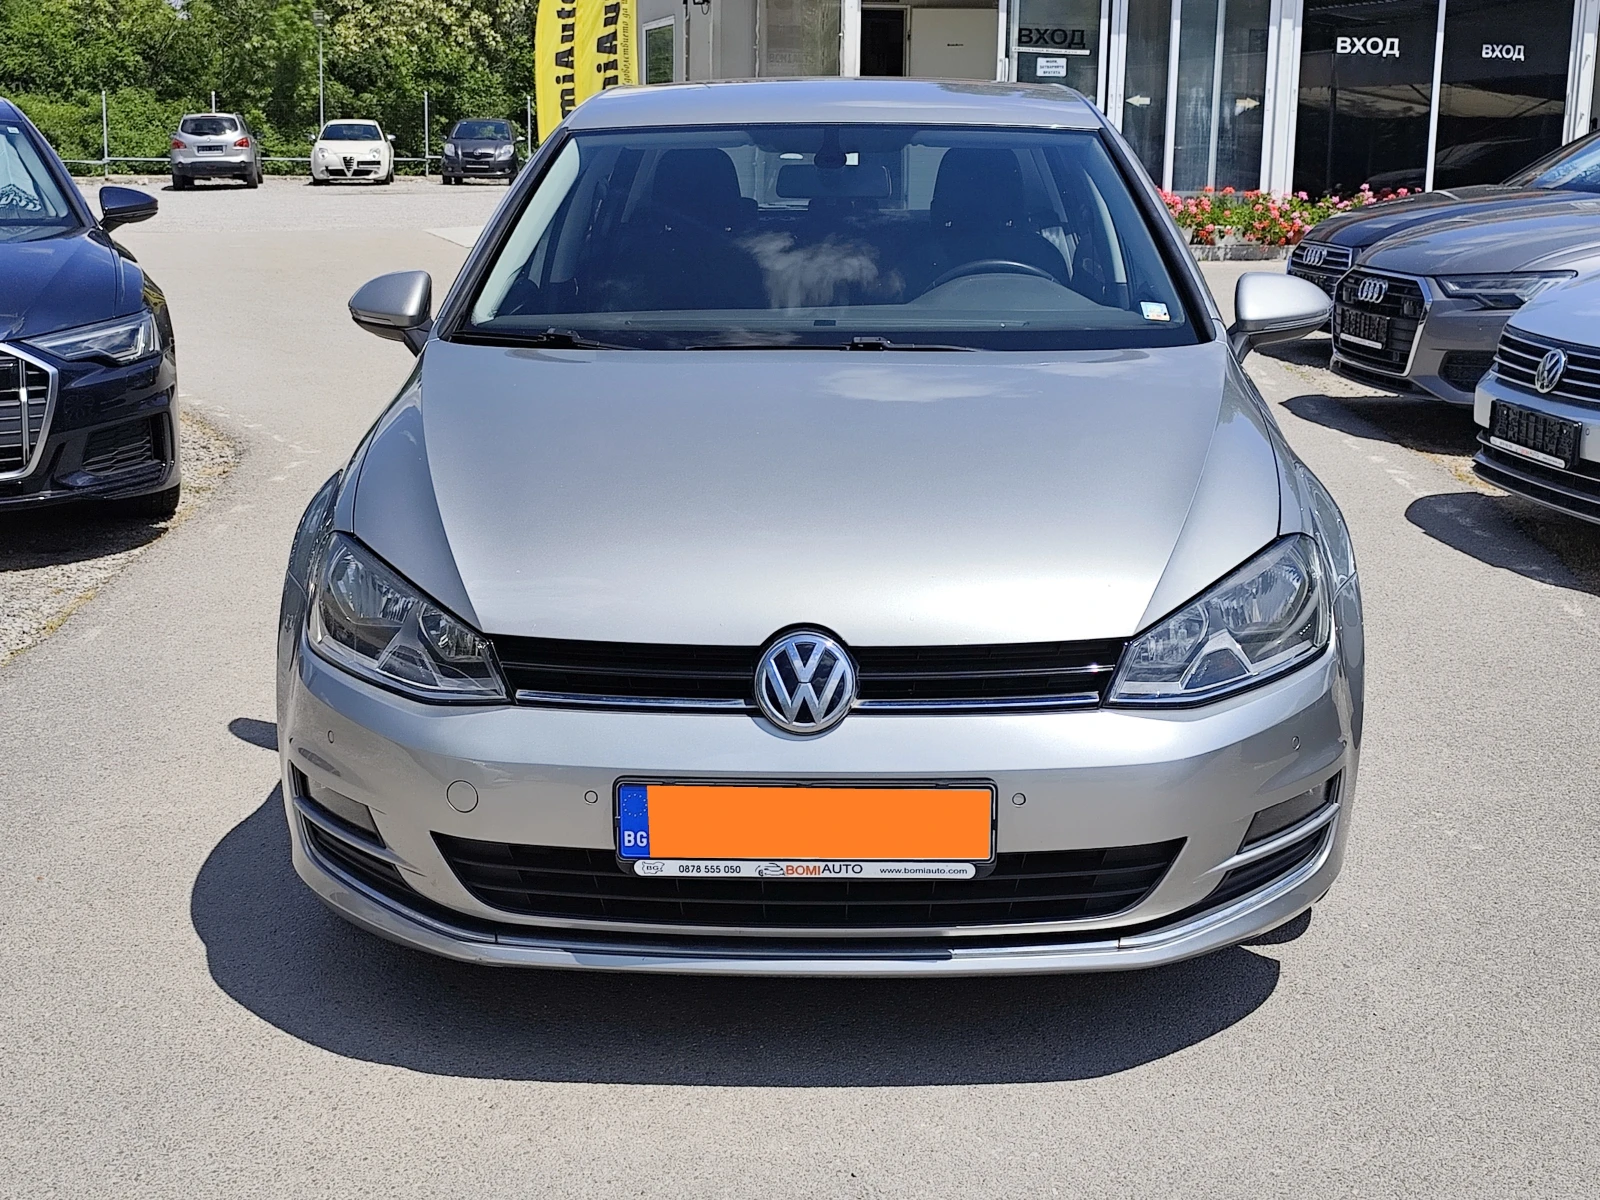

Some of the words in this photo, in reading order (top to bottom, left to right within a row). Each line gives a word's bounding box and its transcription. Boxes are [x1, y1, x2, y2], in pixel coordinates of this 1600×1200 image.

[1018, 28, 1086, 49] ВХОД
[1336, 37, 1400, 57] ВХОД
[620, 21, 632, 86] доволствието
[1481, 44, 1525, 61] ВХОД
[758, 634, 851, 729] VW
[624, 831, 648, 846] BG
[678, 865, 702, 873] 0878
[704, 865, 721, 874] 555
[723, 866, 741, 874] 050
[880, 867, 968, 875] www.bomiauto.com
